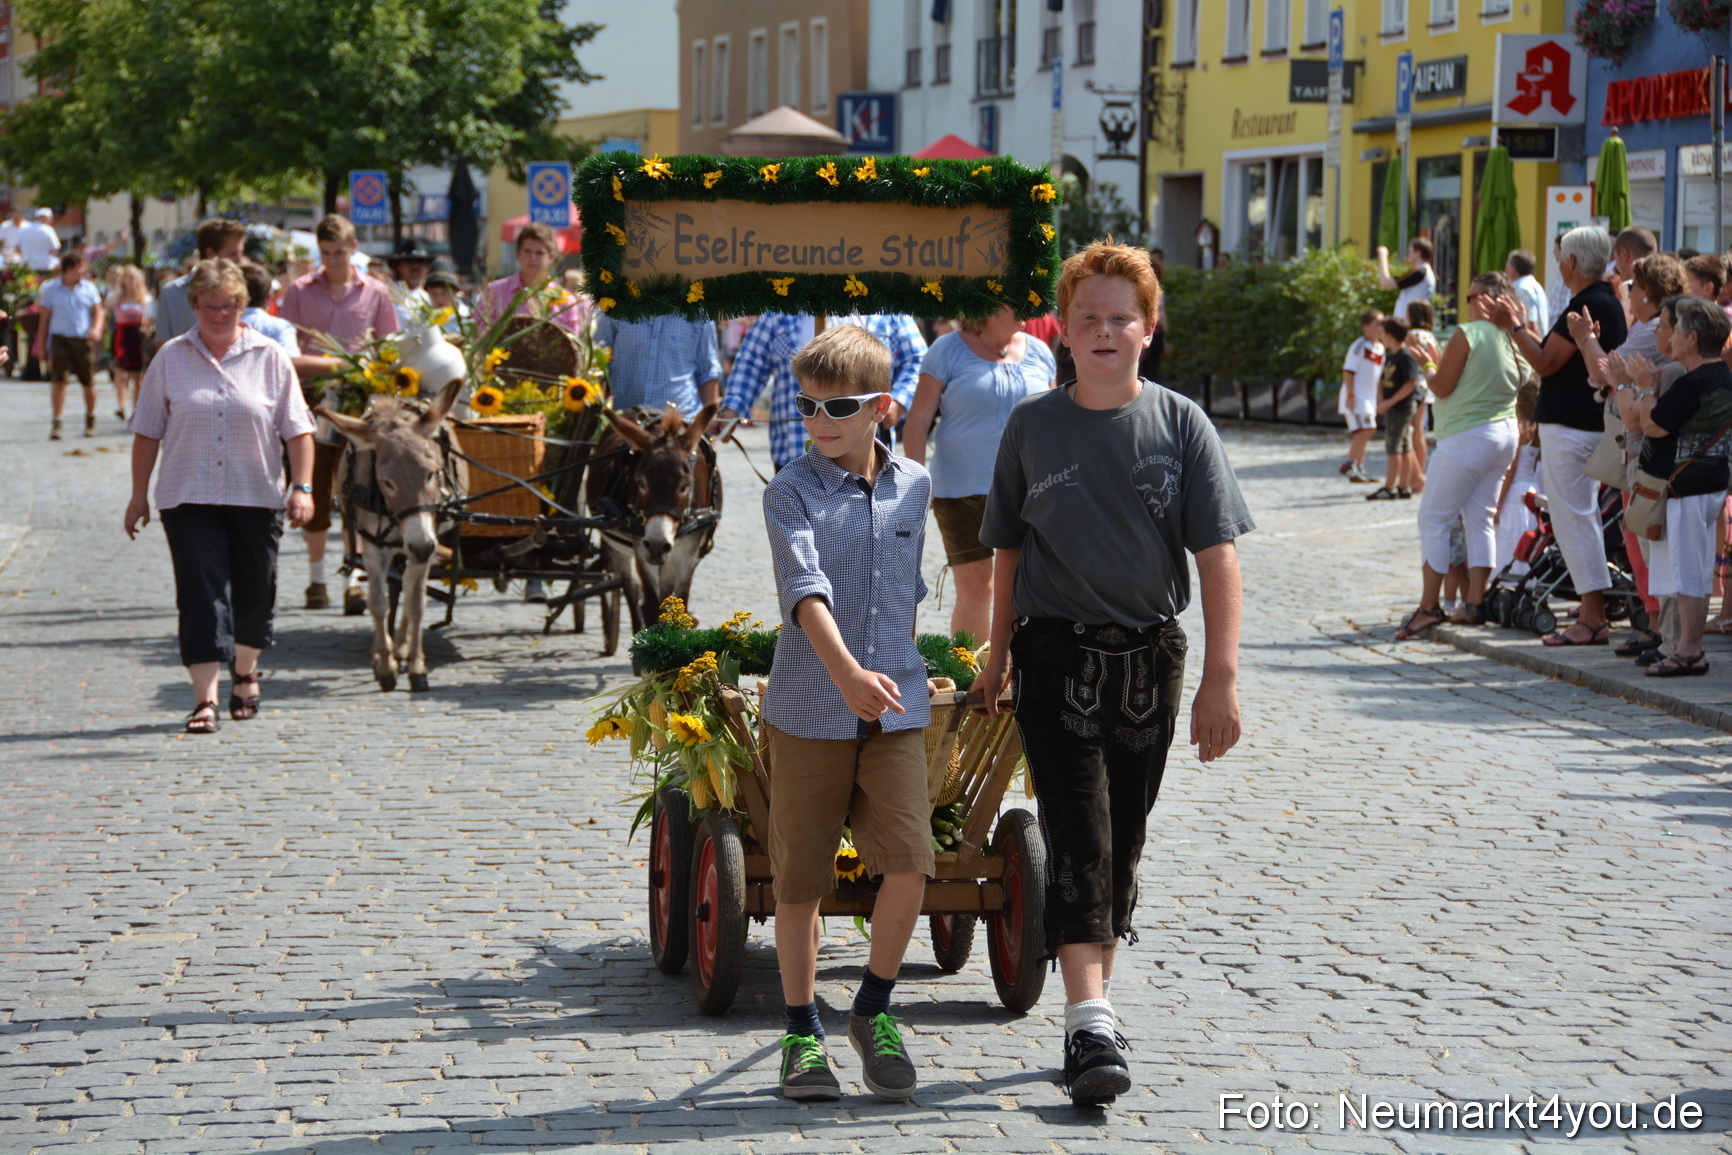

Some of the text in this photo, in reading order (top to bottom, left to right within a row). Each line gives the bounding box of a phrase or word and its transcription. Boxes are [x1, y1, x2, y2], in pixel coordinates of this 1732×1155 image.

[1293, 86, 1352, 98] TAIFN
[1399, 61, 1410, 109] P
[1412, 62, 1455, 93] AIFUN
[1601, 65, 1729, 126] APOTHEK
[1231, 107, 1297, 139] Restaurant
[532, 208, 567, 224] TAXI
[673, 212, 971, 271] Eselfreunde Stauf
[1132, 454, 1174, 475] ESELFREUNDE
